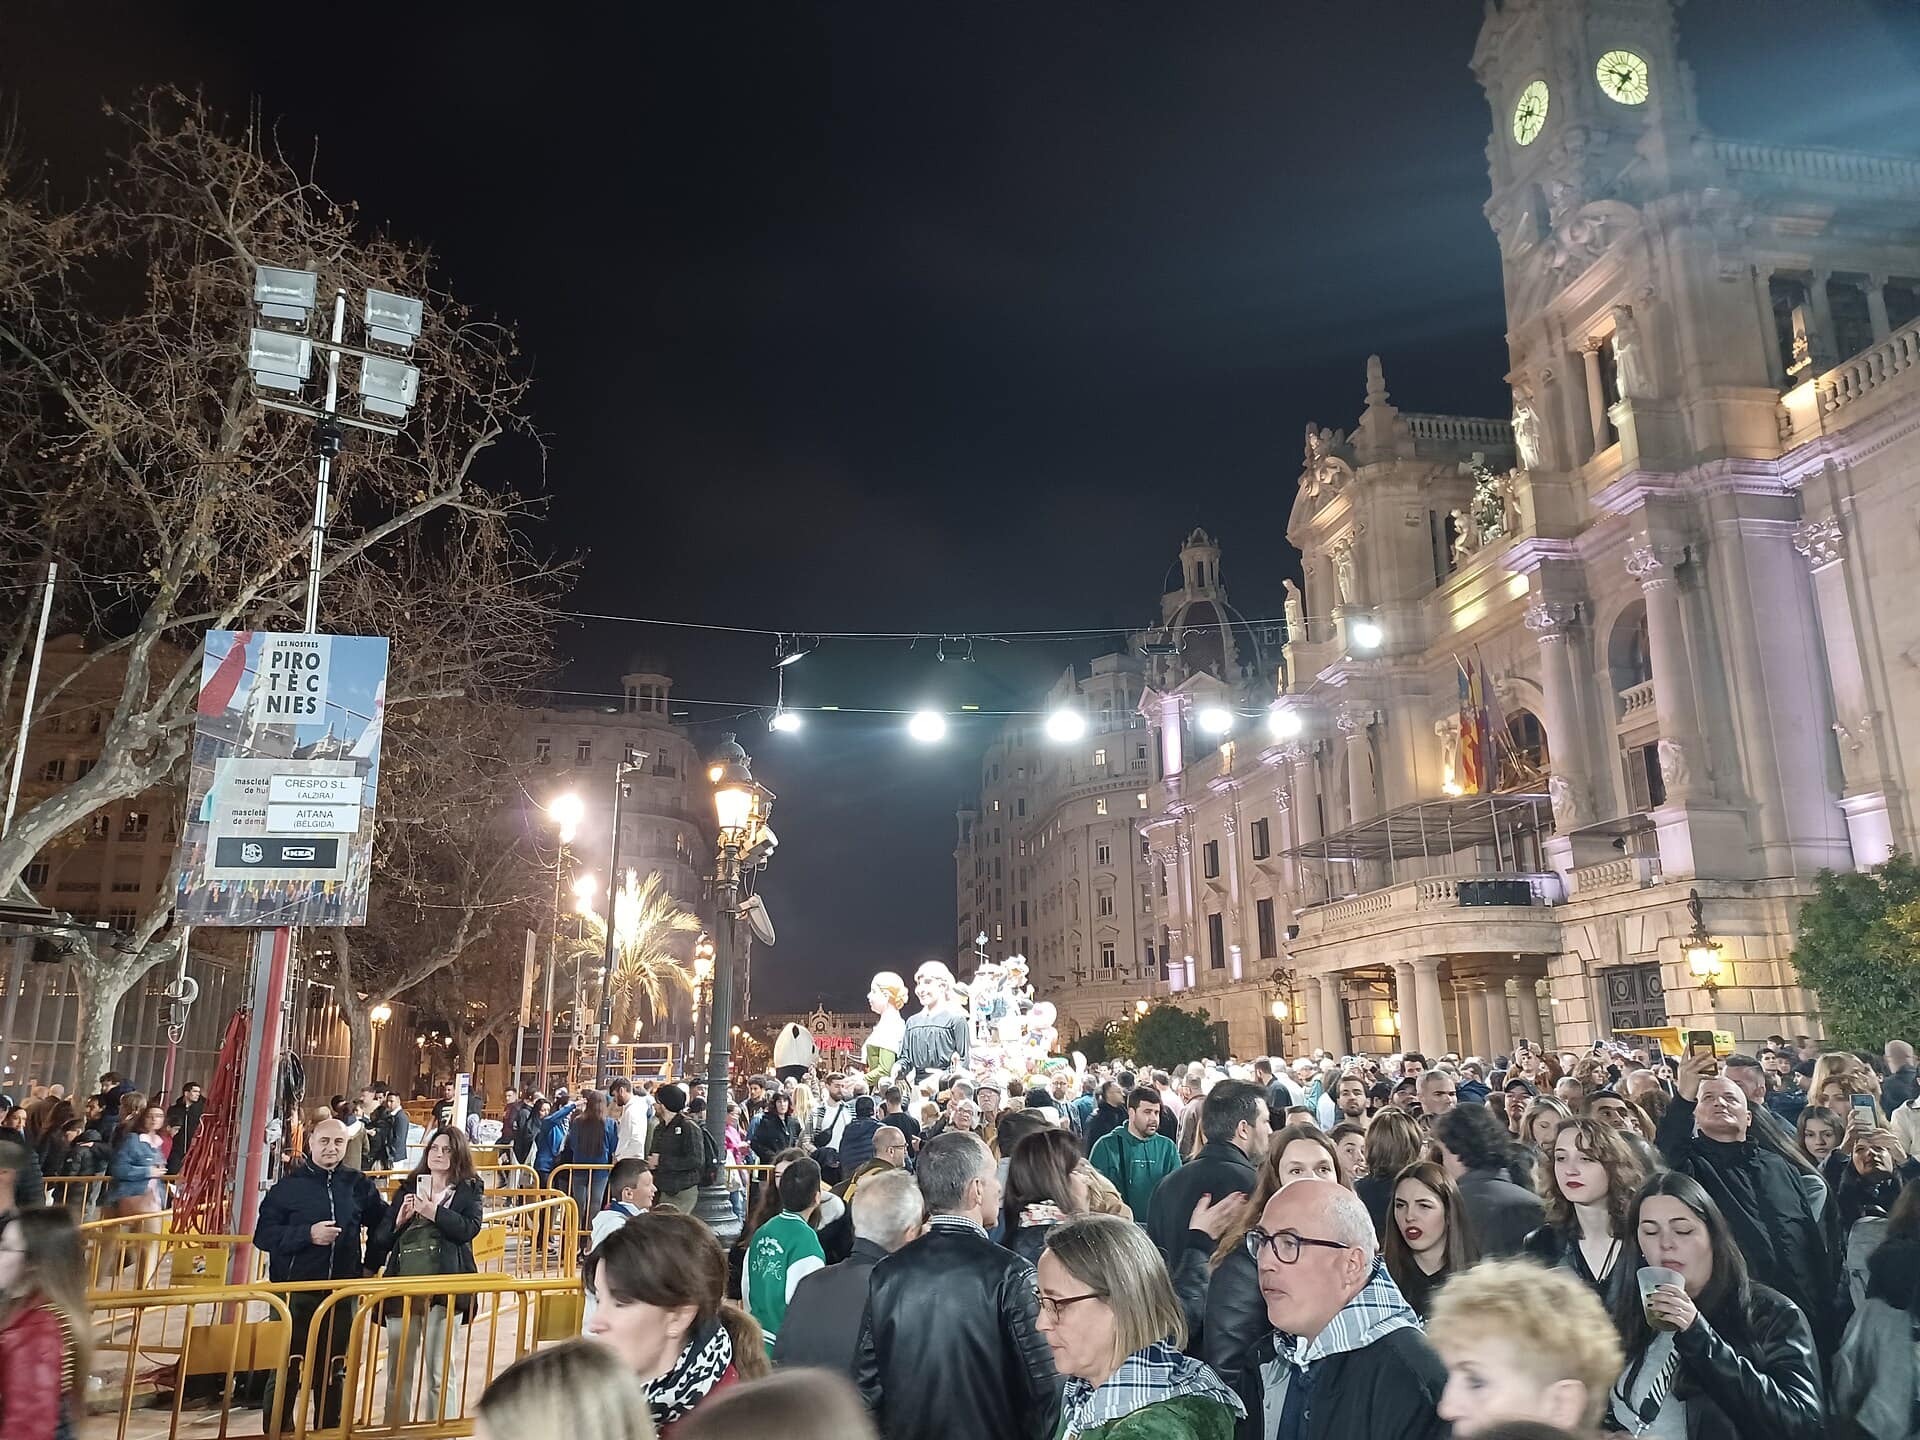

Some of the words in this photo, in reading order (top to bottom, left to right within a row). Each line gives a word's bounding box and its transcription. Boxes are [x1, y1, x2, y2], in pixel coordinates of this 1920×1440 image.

[289, 641, 319, 649] NOSTRES
[271, 651, 321, 670] PIRO
[266, 695, 317, 714] NIES
[285, 779, 328, 789] CRESPO
[296, 809, 334, 818] AITANA
